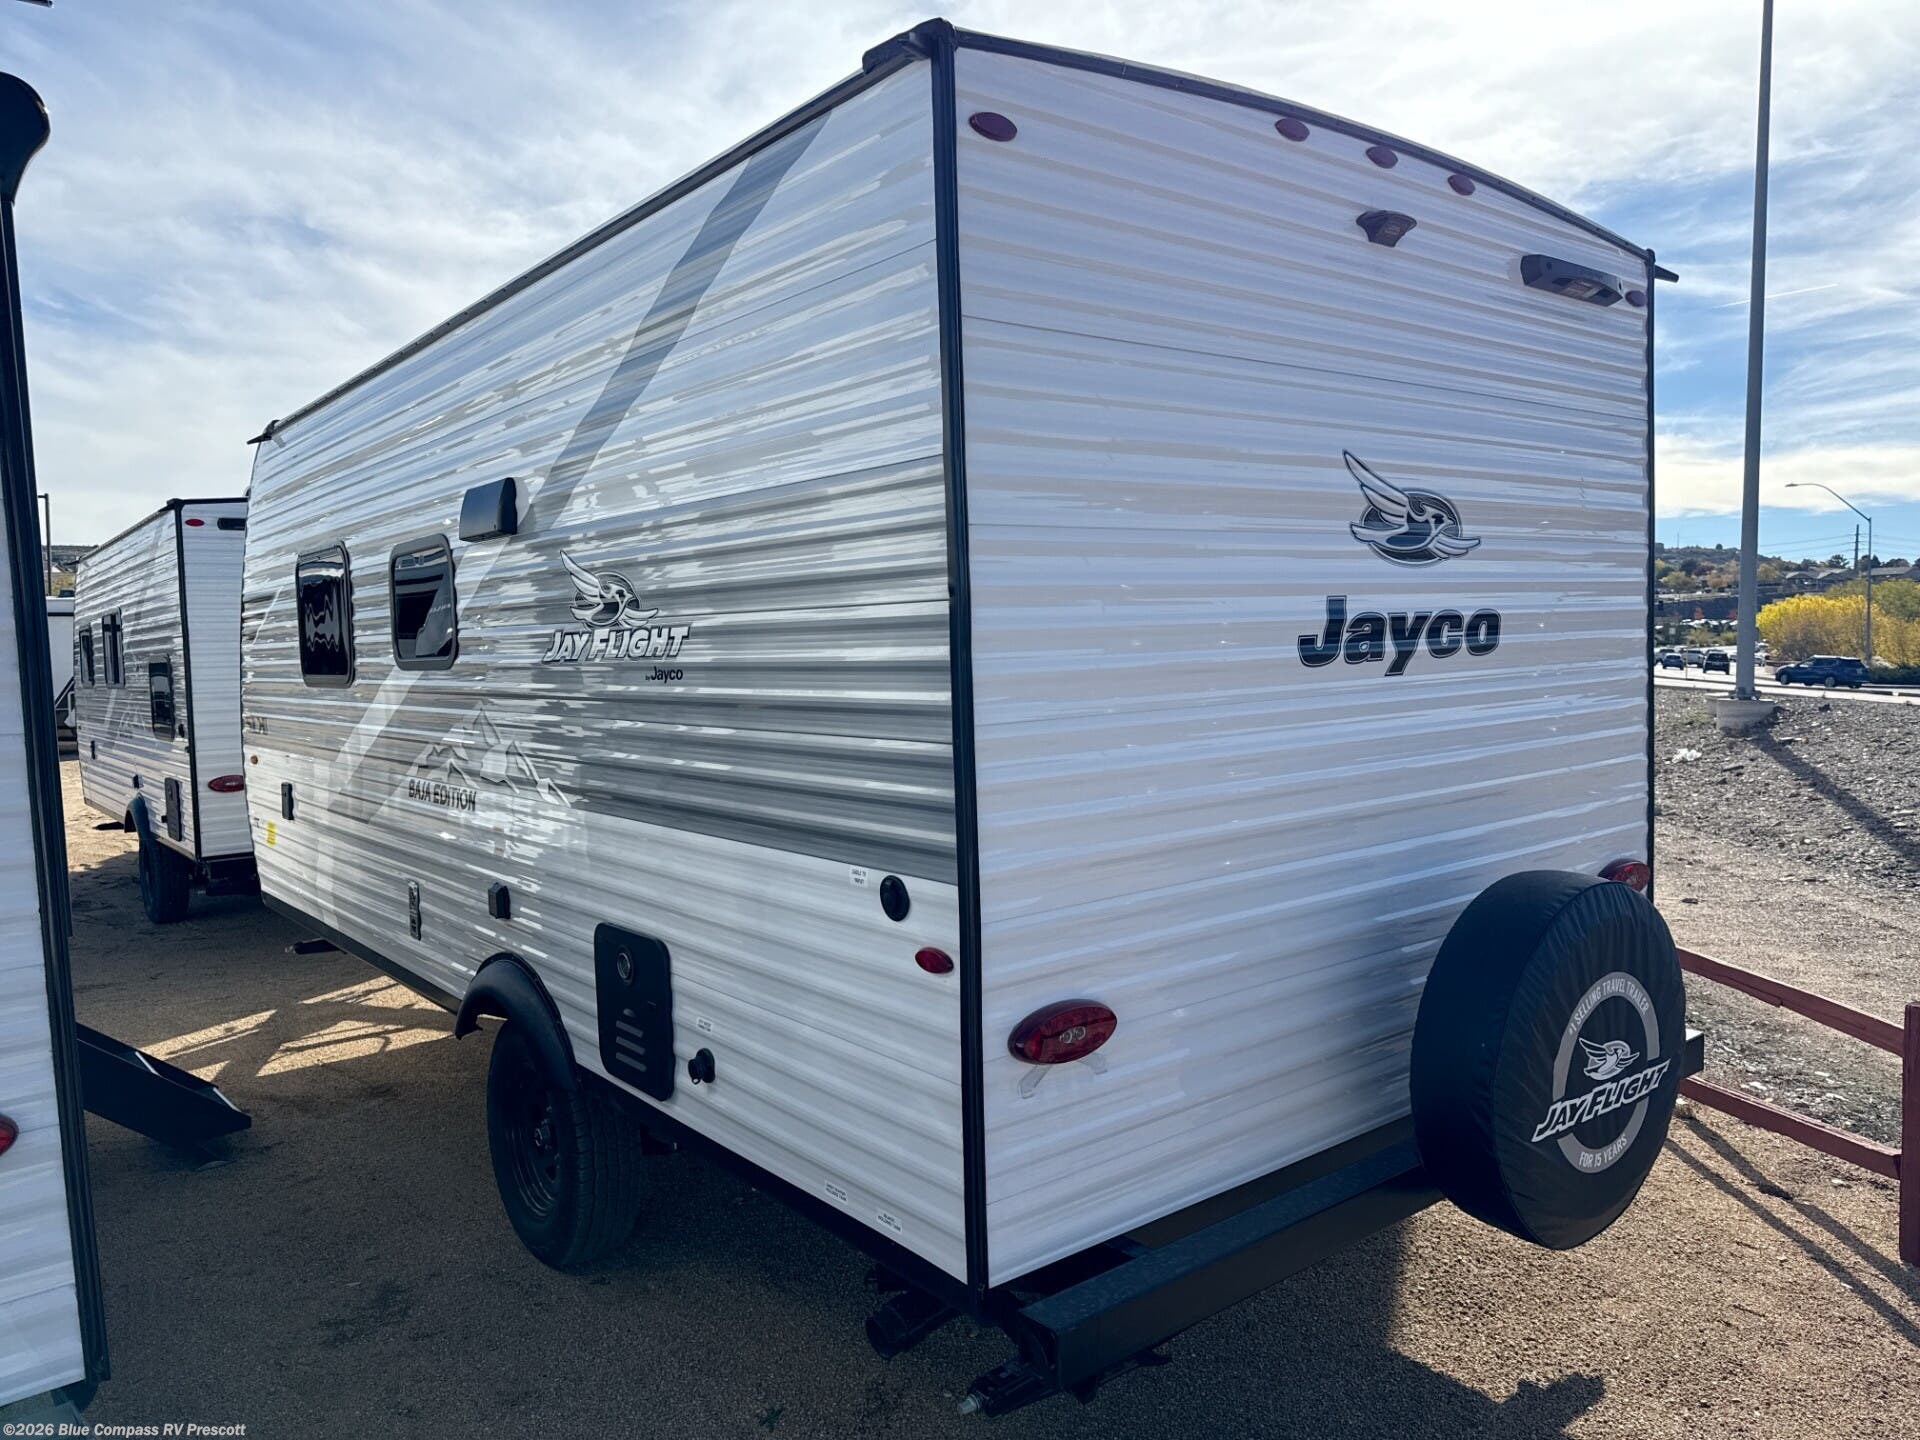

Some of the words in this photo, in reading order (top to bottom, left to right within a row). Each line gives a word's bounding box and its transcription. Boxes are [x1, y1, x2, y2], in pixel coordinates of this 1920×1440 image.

[542, 630, 591, 664] JAY
[586, 625, 691, 661] FLIGHT
[1297, 594, 1502, 677] Jayco
[650, 666, 683, 684] Jayco
[408, 778, 432, 803] BAJA
[433, 783, 477, 812] EDITION
[1574, 986, 1602, 1025] SELLING
[1602, 978, 1626, 996] TRAVEL
[1626, 981, 1650, 1016] TRAILER
[1531, 1095, 1588, 1142] JAY
[1580, 1058, 1671, 1123] FLIGHT
[1579, 1151, 1594, 1168] FOR
[1594, 1153, 1602, 1168] 15
[1603, 1133, 1628, 1164] YEARS
